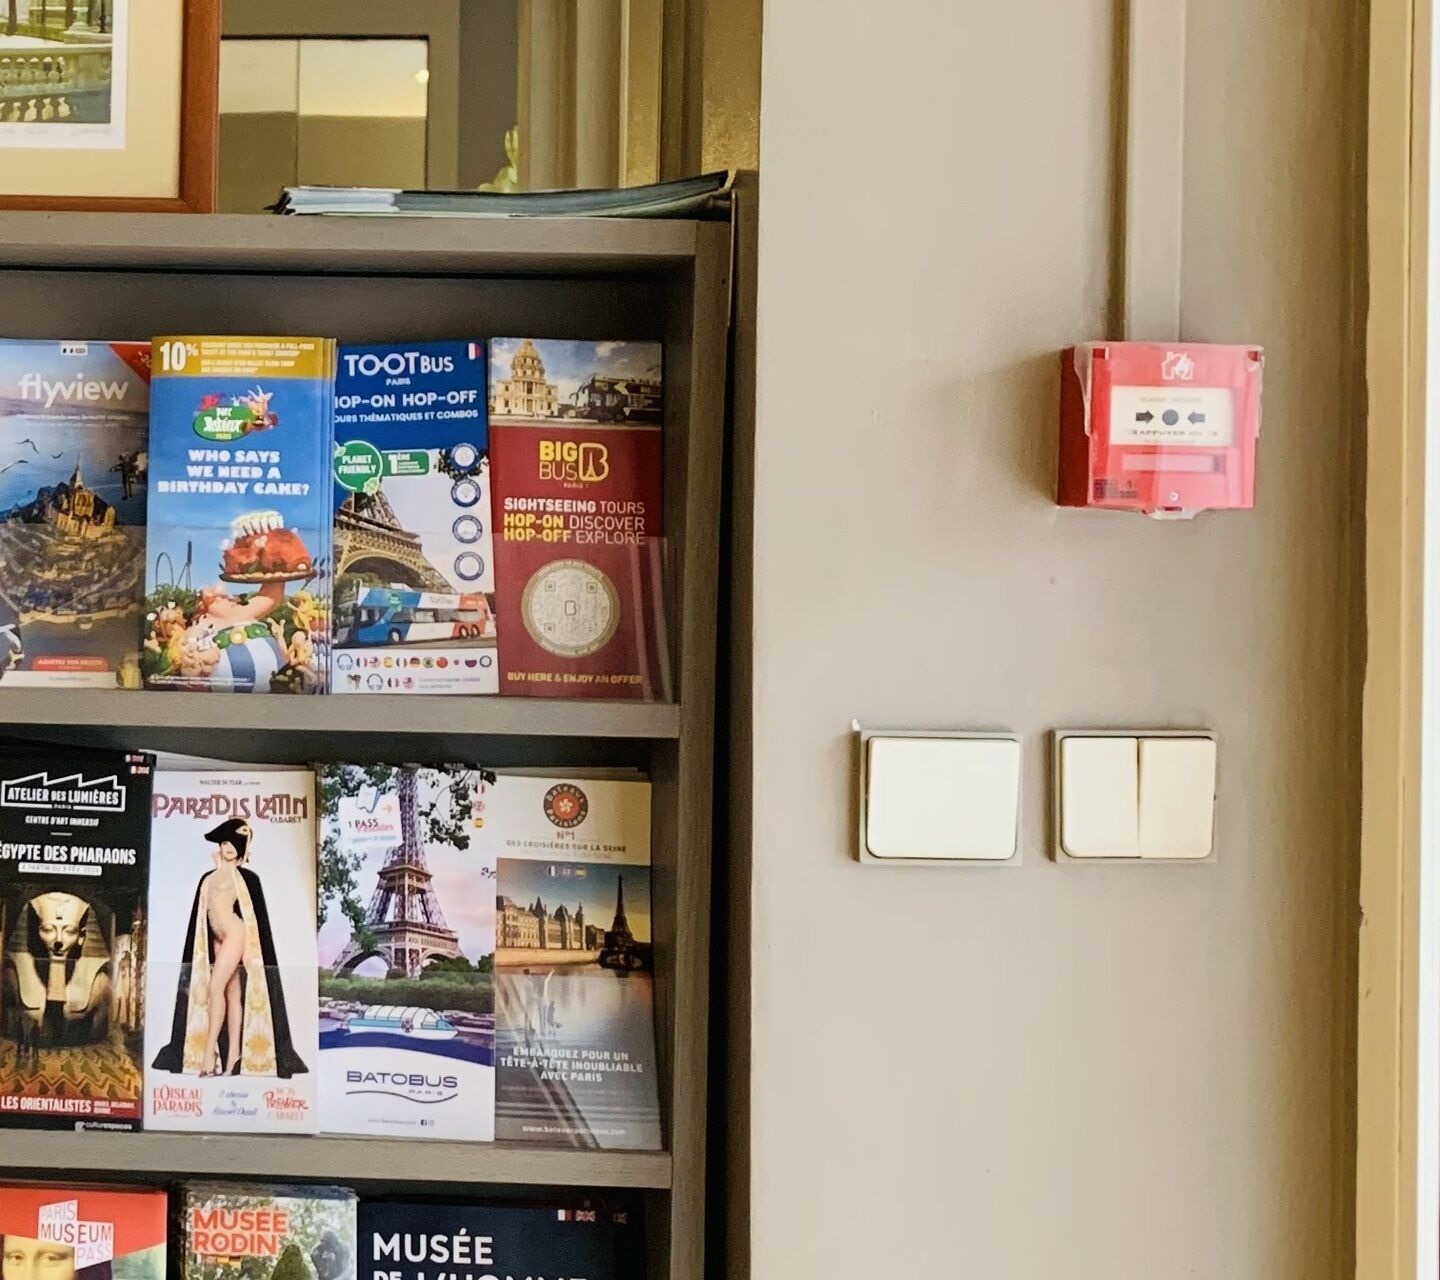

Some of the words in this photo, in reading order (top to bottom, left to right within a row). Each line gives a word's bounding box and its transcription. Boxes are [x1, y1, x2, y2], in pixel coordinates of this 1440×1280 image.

[159, 341, 200, 371] 10%
[18, 372, 130, 407] flyview
[187, 449, 231, 463] WHO
[234, 450, 280, 464] SAYS
[539, 440, 578, 462] BIG
[186, 466, 214, 478] WE
[217, 466, 263, 479] NEED
[267, 467, 282, 479] A
[539, 462, 578, 481] BUS
[157, 481, 250, 494] BIRTHDAY
[252, 482, 310, 496] CAKE?
[503, 497, 597, 513] SIGHTSEEING
[599, 500, 646, 514] TOURS
[503, 513, 564, 528] HOP-ON
[568, 516, 646, 531] DISCOVER
[503, 528, 572, 543] HOP-OFF
[575, 530, 646, 545] EXPLORE
[7, 787, 50, 802] ATELIER
[51, 791, 67, 802] DES
[68, 787, 119, 805] LUMIÈRES
[152, 792, 251, 819] PARADIS
[255, 793, 308, 819] LATIN
[43, 845, 68, 861] DES
[70, 846, 137, 865] PHARAONS
[346, 1069, 458, 1088] BATOBUS
[40, 1202, 76, 1221] PARIS
[192, 1208, 289, 1233] MUSÉE
[40, 1222, 113, 1245] MUSEUM
[75, 1243, 113, 1263] PASS
[192, 1232, 278, 1256] RODIN
[372, 1228, 494, 1265] MUSÉE
